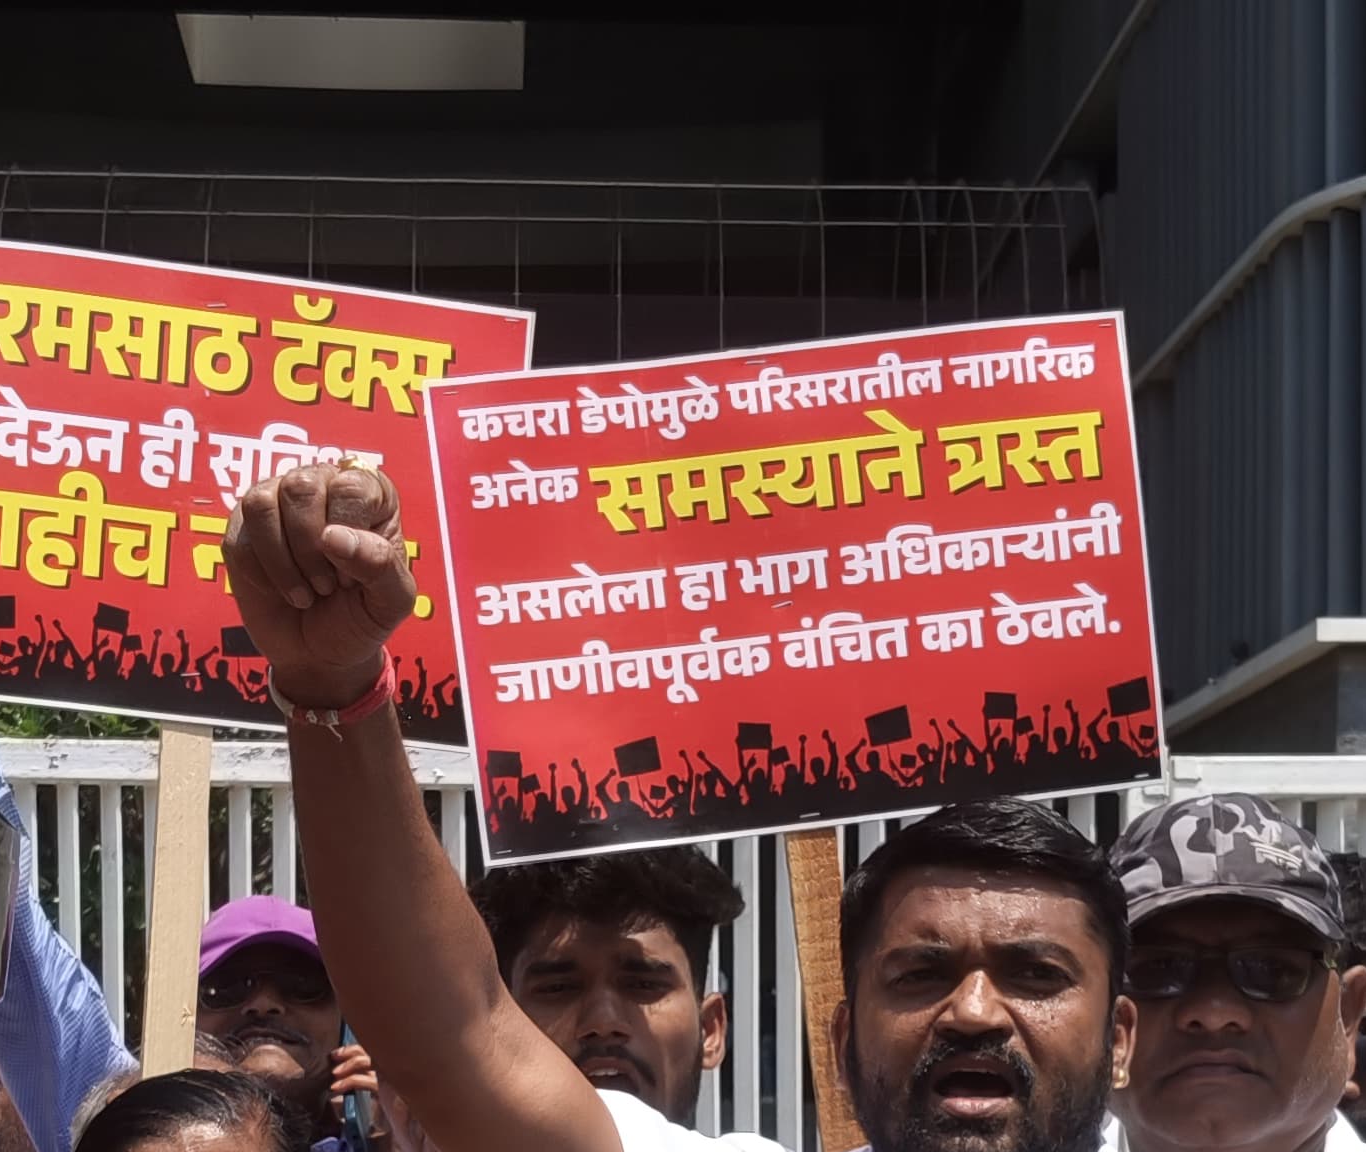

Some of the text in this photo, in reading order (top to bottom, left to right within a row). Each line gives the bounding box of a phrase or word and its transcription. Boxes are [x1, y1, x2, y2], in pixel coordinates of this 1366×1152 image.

[272, 294, 454, 414] टॅक्स
[457, 336, 1096, 442] कचरा डेपोमुळे परिसरातील नागरिक
[138, 407, 200, 489] ही
[469, 409, 1104, 533] अनेक समस्याने त्रस्त
[475, 562, 668, 626] असलेला
[673, 561, 728, 611] हा
[734, 548, 829, 597] भाग
[489, 582, 1121, 704] जाणीवपूर्वक वंचित का ठेवले.
